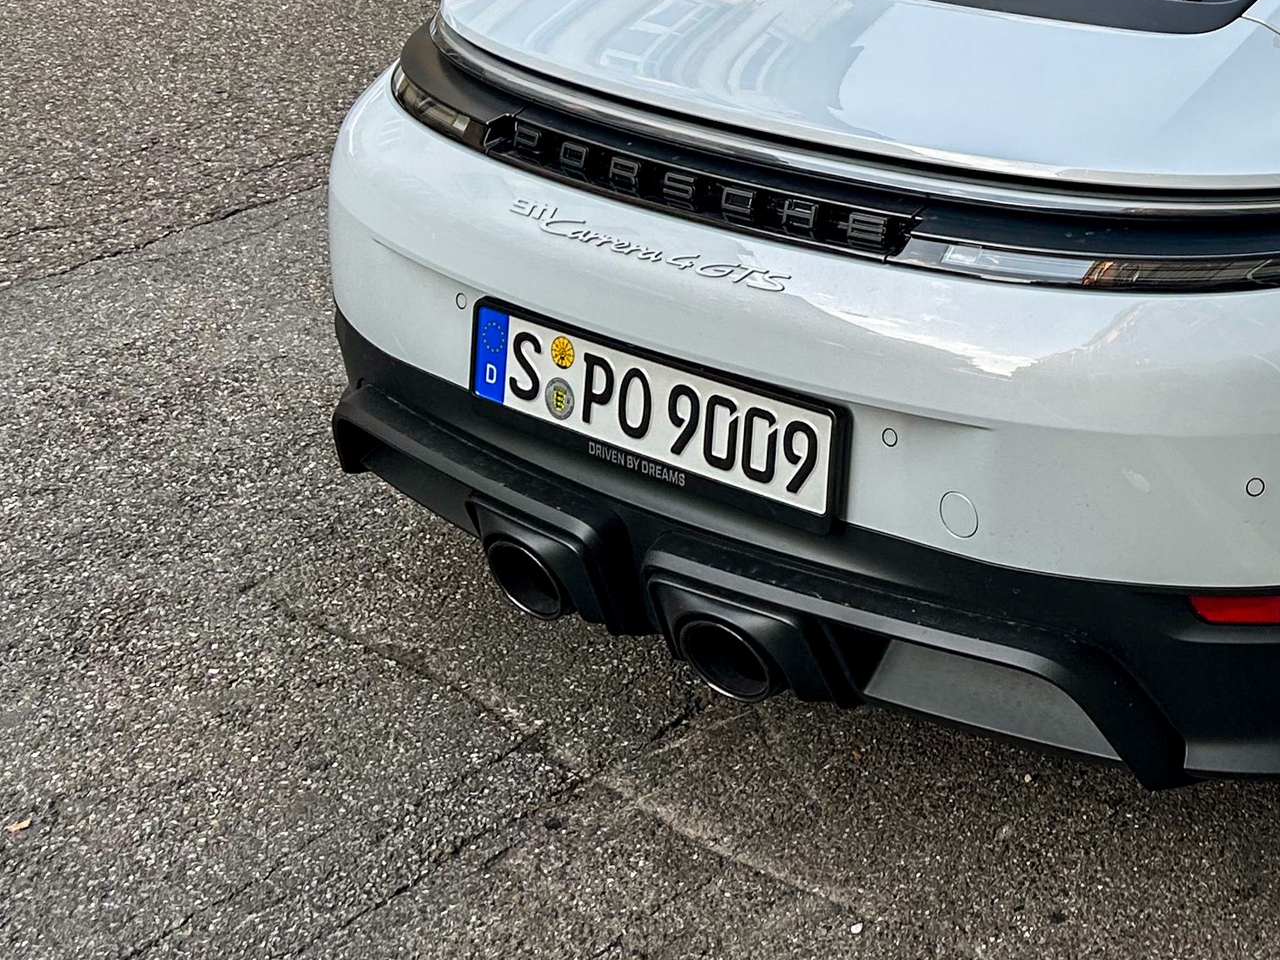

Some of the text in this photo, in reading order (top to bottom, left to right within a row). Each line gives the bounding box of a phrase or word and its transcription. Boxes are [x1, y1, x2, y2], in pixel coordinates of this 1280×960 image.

[514, 127, 890, 243] PORSCHE
[509, 197, 792, 292] 911 Carrera 4 GTS
[485, 363, 497, 385] D
[508, 331, 819, 494] S PO 9009
[588, 441, 686, 487] DRIVEN BY DREAMS
